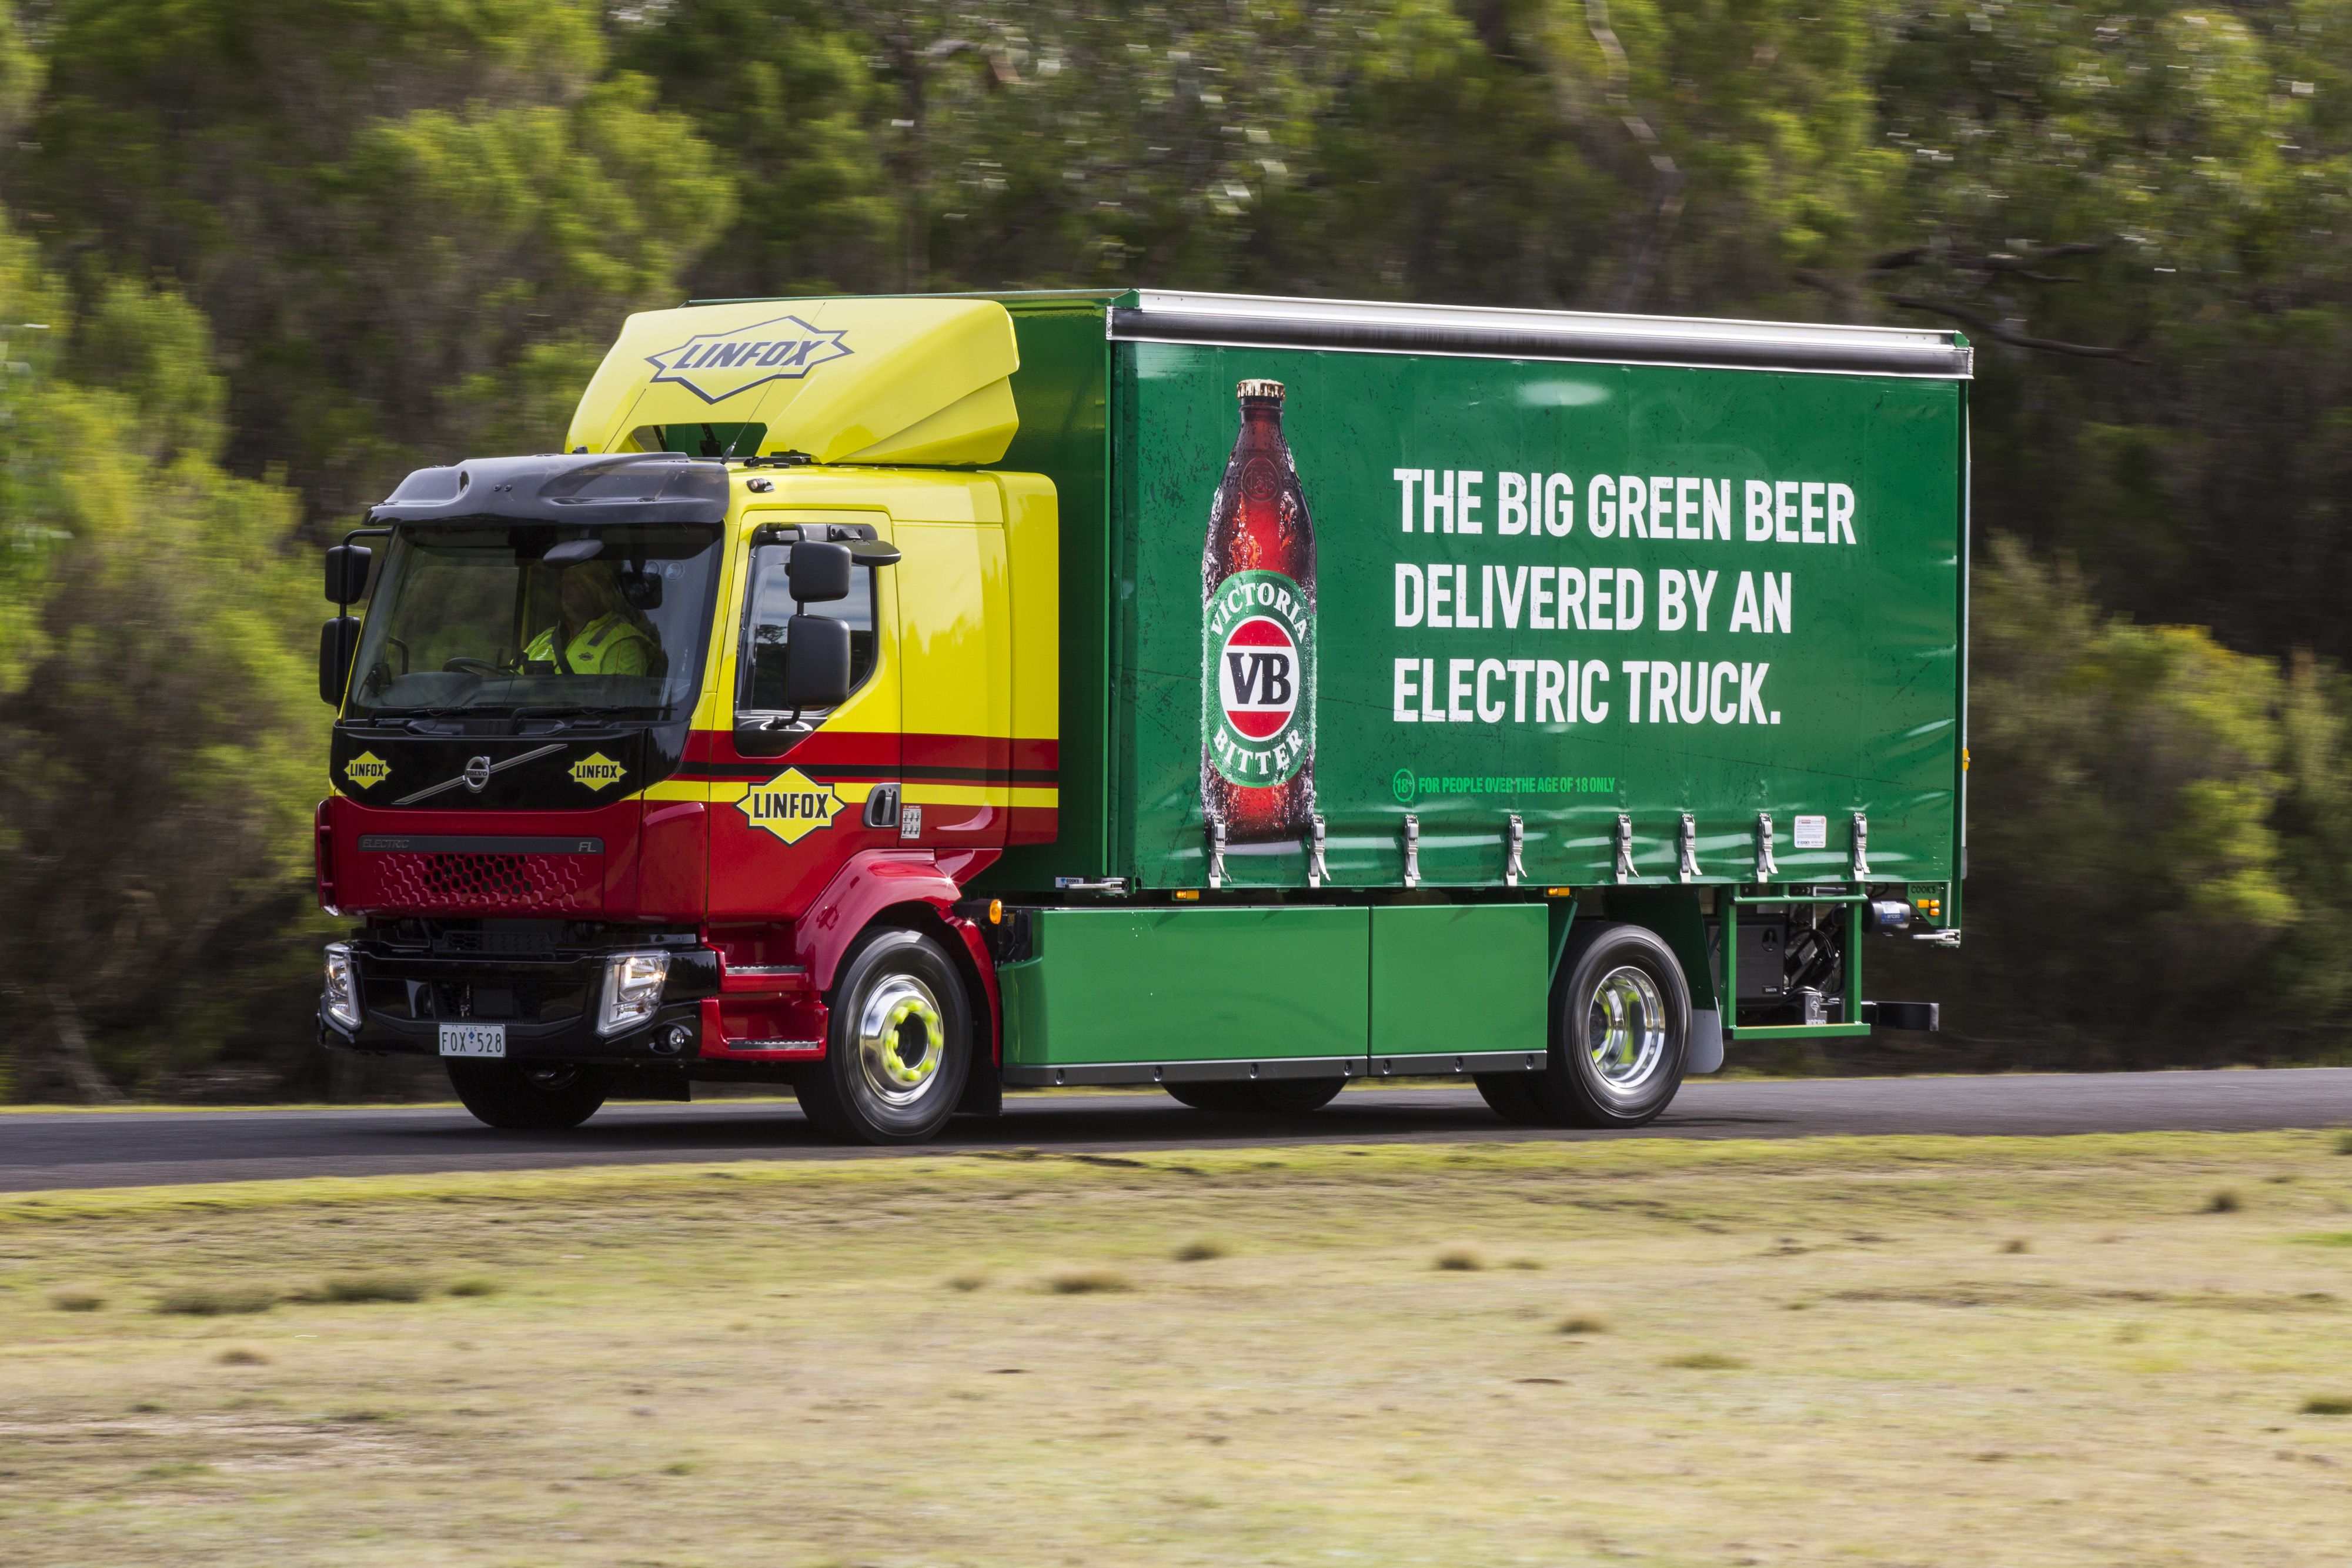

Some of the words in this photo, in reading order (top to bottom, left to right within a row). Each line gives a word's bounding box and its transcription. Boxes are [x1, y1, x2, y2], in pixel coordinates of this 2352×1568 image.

[671, 339, 825, 370] LINFOX
[1393, 468, 1484, 534] THE
[1498, 471, 1574, 537] BIG
[1588, 474, 1731, 541] GREEN
[1745, 479, 1857, 544] BEER
[1394, 563, 1645, 631] DELIVERED
[1658, 569, 1719, 632] BY
[1729, 571, 1792, 634] AN
[1211, 582, 1308, 644] VICTORIA
[1226, 652, 1292, 705] VB
[1393, 658, 1610, 724] ELECTRIC
[1622, 660, 1782, 725] TRUCK.
[1213, 724, 1303, 775] BITTER
[349, 763, 385, 777] LINFOX
[576, 764, 619, 779] LINFOX
[1395, 778, 1413, 794] 18+
[1418, 777, 1440, 793] FOR
[1442, 777, 1483, 793] PEOPLE
[1485, 777, 1514, 793] OVER
[1515, 777, 1536, 793] THE
[1536, 777, 1559, 793] AGE
[1559, 777, 1574, 793] OF
[1575, 777, 1588, 793] 18
[1589, 777, 1615, 793] ONLY
[753, 793, 828, 818] LINFOX
[363, 839, 410, 848] ELECTRIC
[578, 842, 597, 852] FL
[441, 1031, 466, 1052] FOX
[477, 1032, 502, 1053] 528
